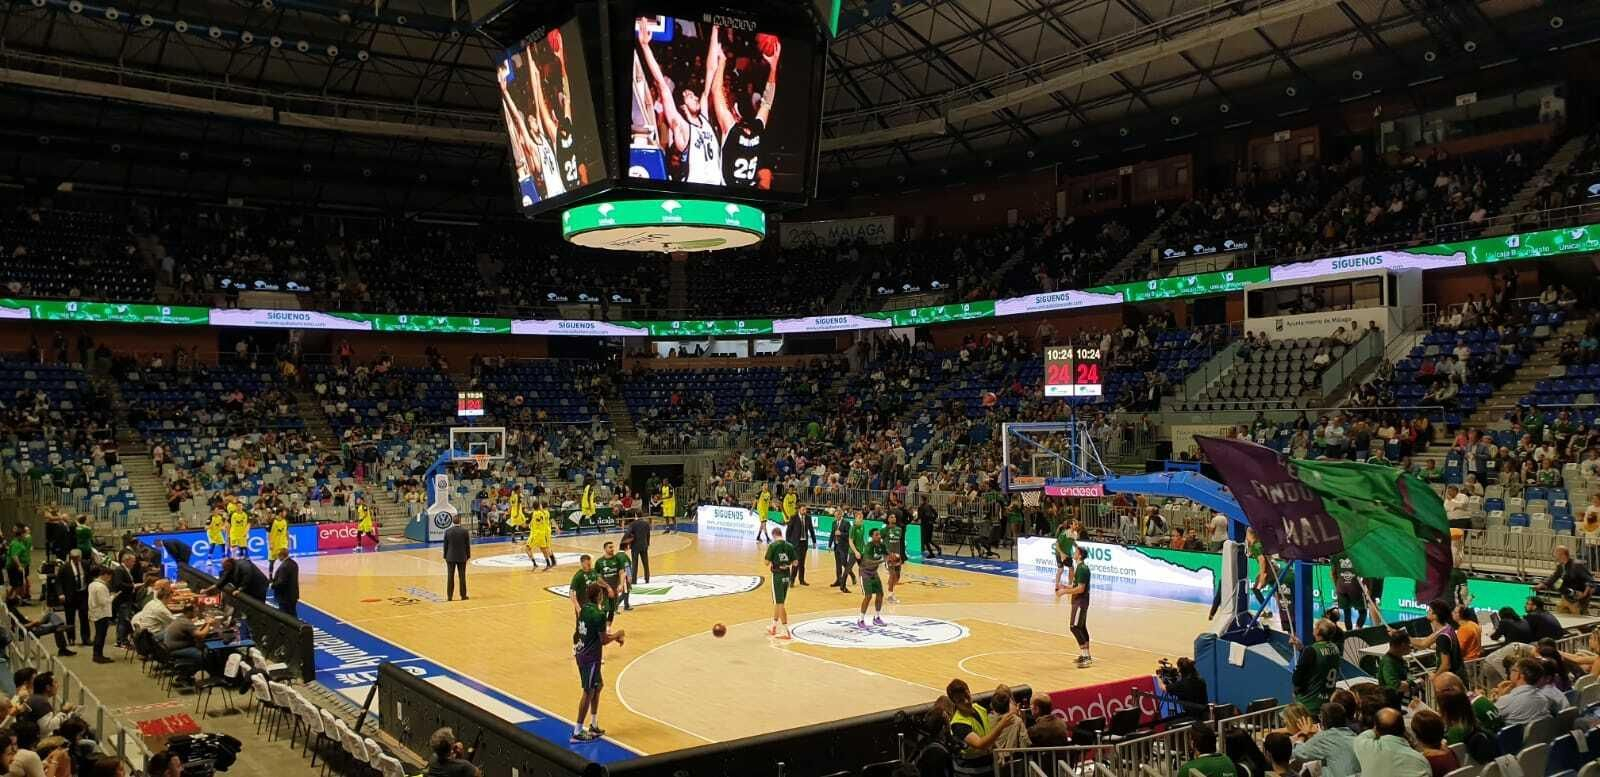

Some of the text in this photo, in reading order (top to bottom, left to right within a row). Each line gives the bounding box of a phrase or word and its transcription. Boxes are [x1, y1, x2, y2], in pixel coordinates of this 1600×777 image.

[1047, 350, 1073, 361] 10:24
[1076, 349, 1101, 360] 10:24
[1048, 363, 1071, 385] 24
[1077, 363, 1098, 385] 24
[1060, 485, 1098, 497] endesa
